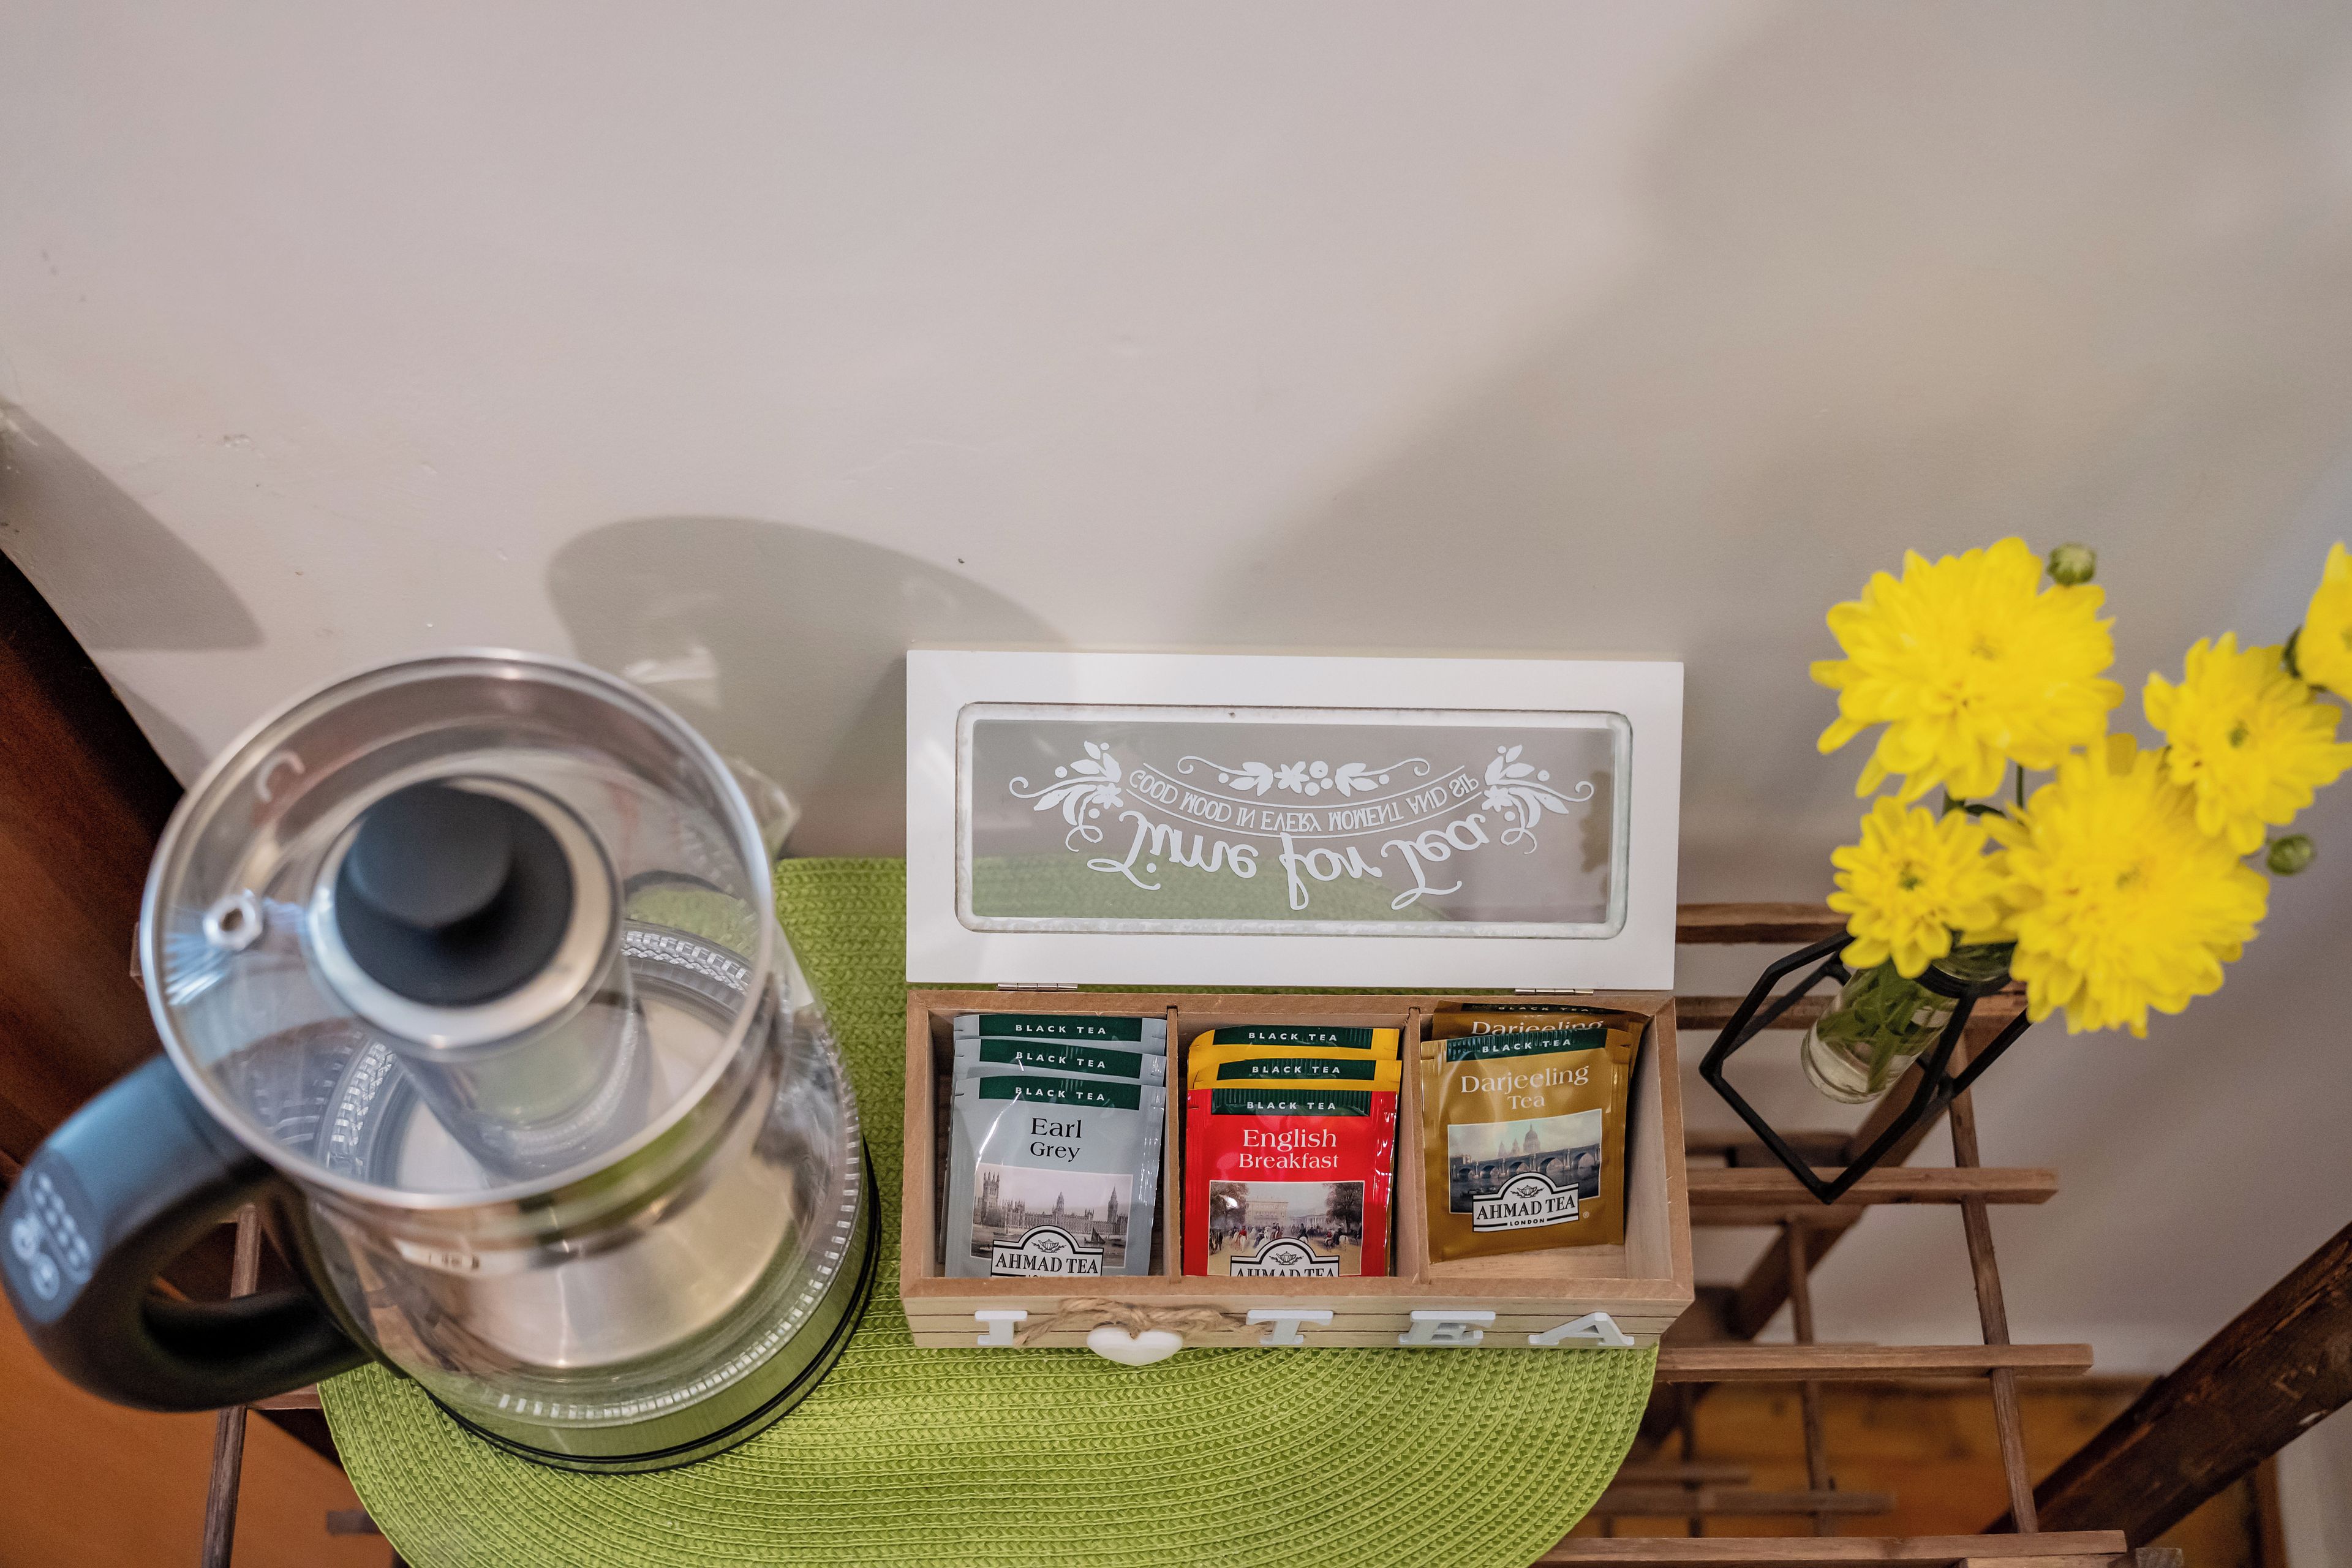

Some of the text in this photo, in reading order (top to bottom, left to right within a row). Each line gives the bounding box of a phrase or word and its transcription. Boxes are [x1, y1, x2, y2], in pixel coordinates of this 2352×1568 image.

[1016, 1025, 1066, 1033] BLACK
[1482, 1039, 1571, 1053] BLACK TEA
[1016, 1052, 1106, 1069] BLACK TEA
[1461, 1066, 1589, 1095] Darjeeling
[1015, 1087, 1105, 1101] BLACK TEA
[1507, 1095, 1545, 1110] Tea
[1031, 1118, 1082, 1139] Earl
[1242, 1128, 1337, 1152] English
[1030, 1141, 1080, 1162] Grey
[1238, 1152, 1339, 1169] Breakfast
[1477, 1194, 1576, 1219] AHMAD TEA
[1510, 1218, 1545, 1226] LONDON
[995, 1253, 1098, 1274] AHMAD TEA
